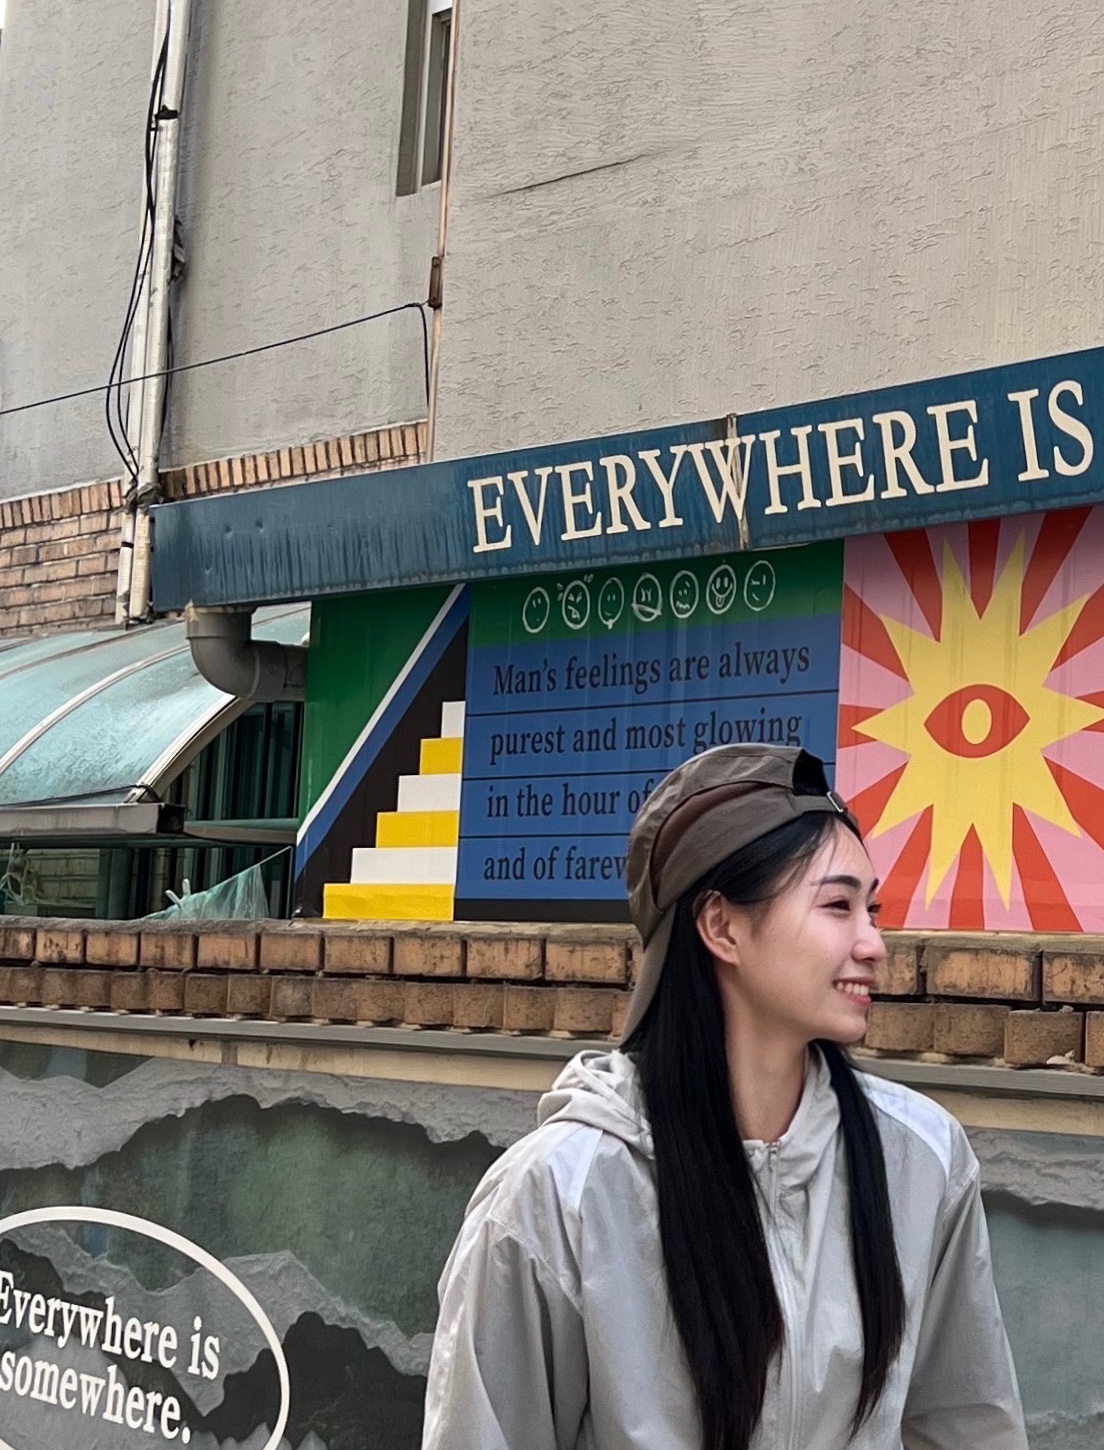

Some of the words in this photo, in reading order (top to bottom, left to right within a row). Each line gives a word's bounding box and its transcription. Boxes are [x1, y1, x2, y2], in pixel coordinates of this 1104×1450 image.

[467, 400, 989, 554] EVERYWHERE
[1007, 380, 1094, 482] IS
[564, 651, 661, 695] feelings
[668, 653, 710, 683] are
[719, 641, 810, 684] always
[489, 724, 566, 766] purest
[573, 717, 618, 751] and
[625, 717, 686, 750] most
[693, 706, 802, 755] glowing
[486, 785, 513, 818] in
[516, 783, 554, 816] the
[561, 782, 621, 816] hour
[484, 846, 526, 881] and
[533, 845, 560, 880] of
[0, 1270, 178, 1368] Everywhere
[187, 1316, 220, 1380] is
[0, 1350, 191, 1444] somewhere.
